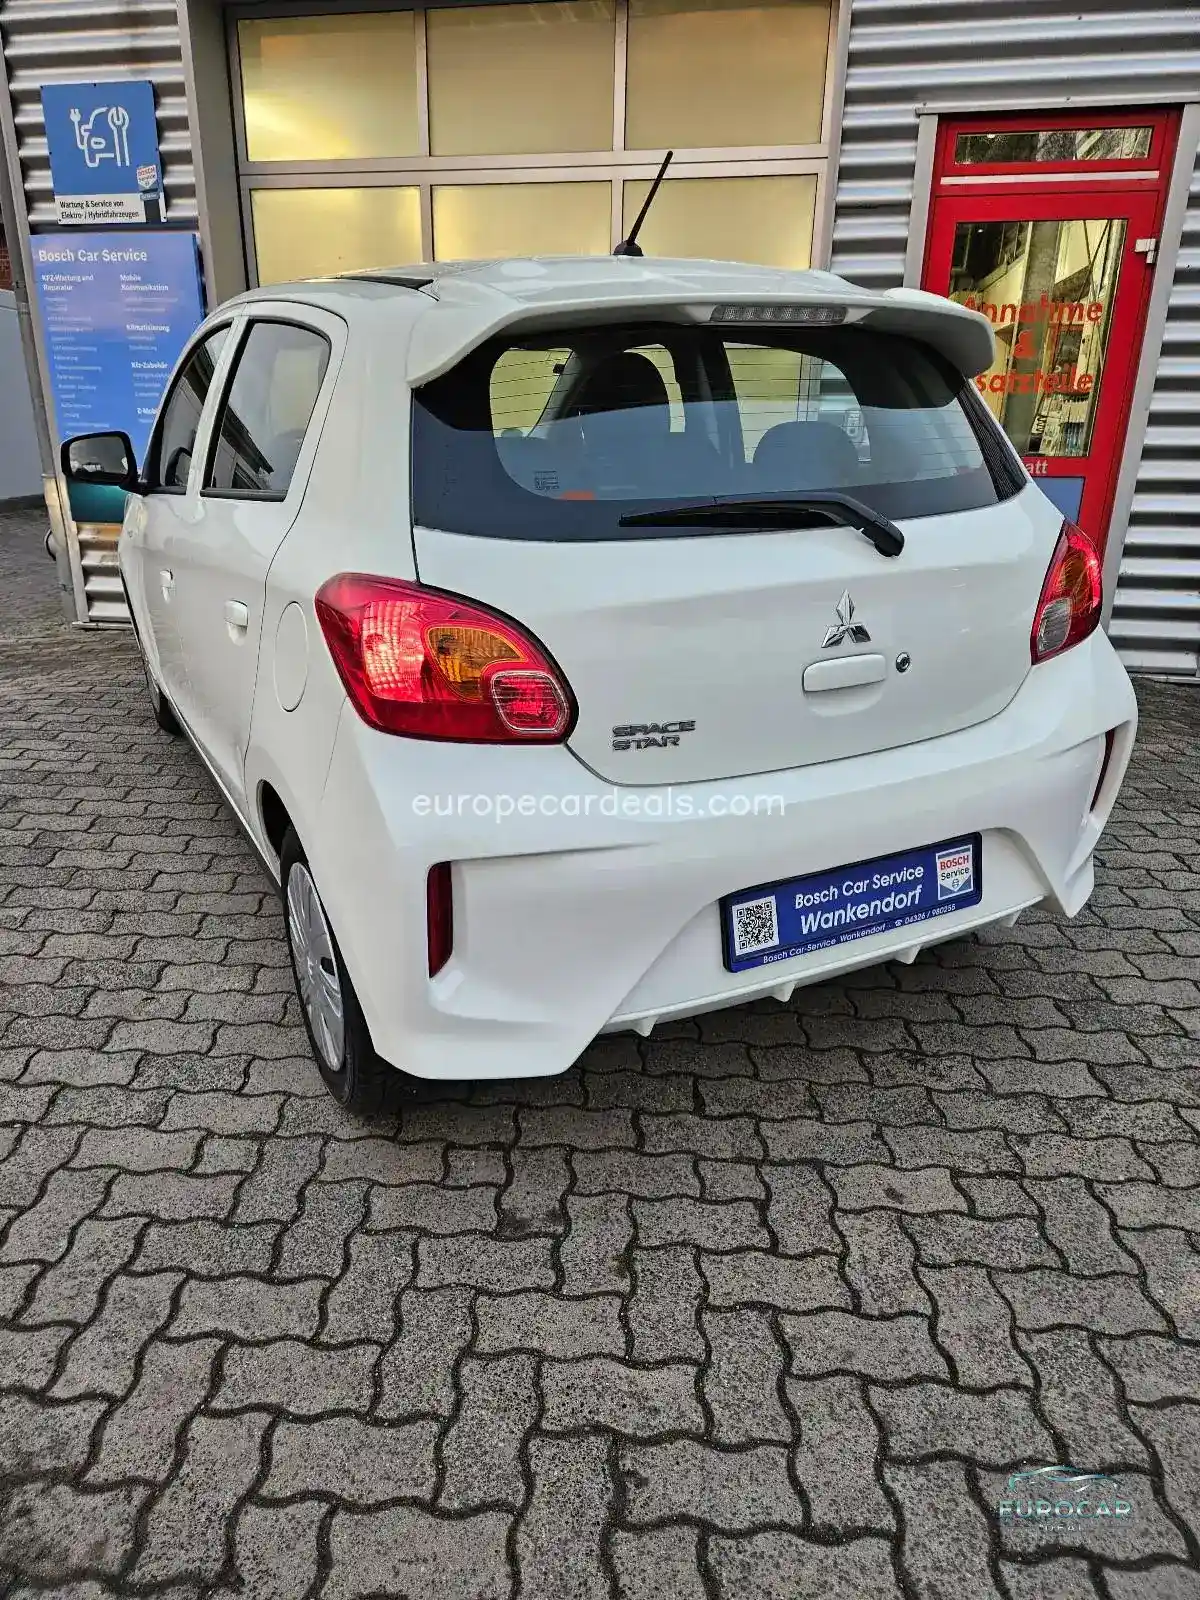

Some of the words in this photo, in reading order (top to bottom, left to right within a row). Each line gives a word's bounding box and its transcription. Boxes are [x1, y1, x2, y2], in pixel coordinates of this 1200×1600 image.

[60, 200, 84, 209] Wartung
[85, 200, 90, 208] &
[90, 200, 112, 208] Service
[88, 211, 139, 220] Hybridfahrzeugen
[38, 249, 75, 262] Bosch
[78, 250, 98, 262] Car
[102, 248, 148, 262] Service
[963, 292, 1103, 323] Annahme
[976, 363, 1094, 393] satzteile
[612, 720, 696, 737] SPACE
[612, 735, 680, 750] STAR
[940, 854, 969, 871] BOSCH
[940, 867, 970, 881] Service
[795, 885, 838, 909] Bosch
[842, 879, 869, 897] Car
[872, 864, 924, 890] Service
[800, 885, 922, 935] Wankendorf
[763, 951, 788, 964] Bosch
[840, 923, 886, 942] Wankendorf
[904, 911, 925, 924] 04326
